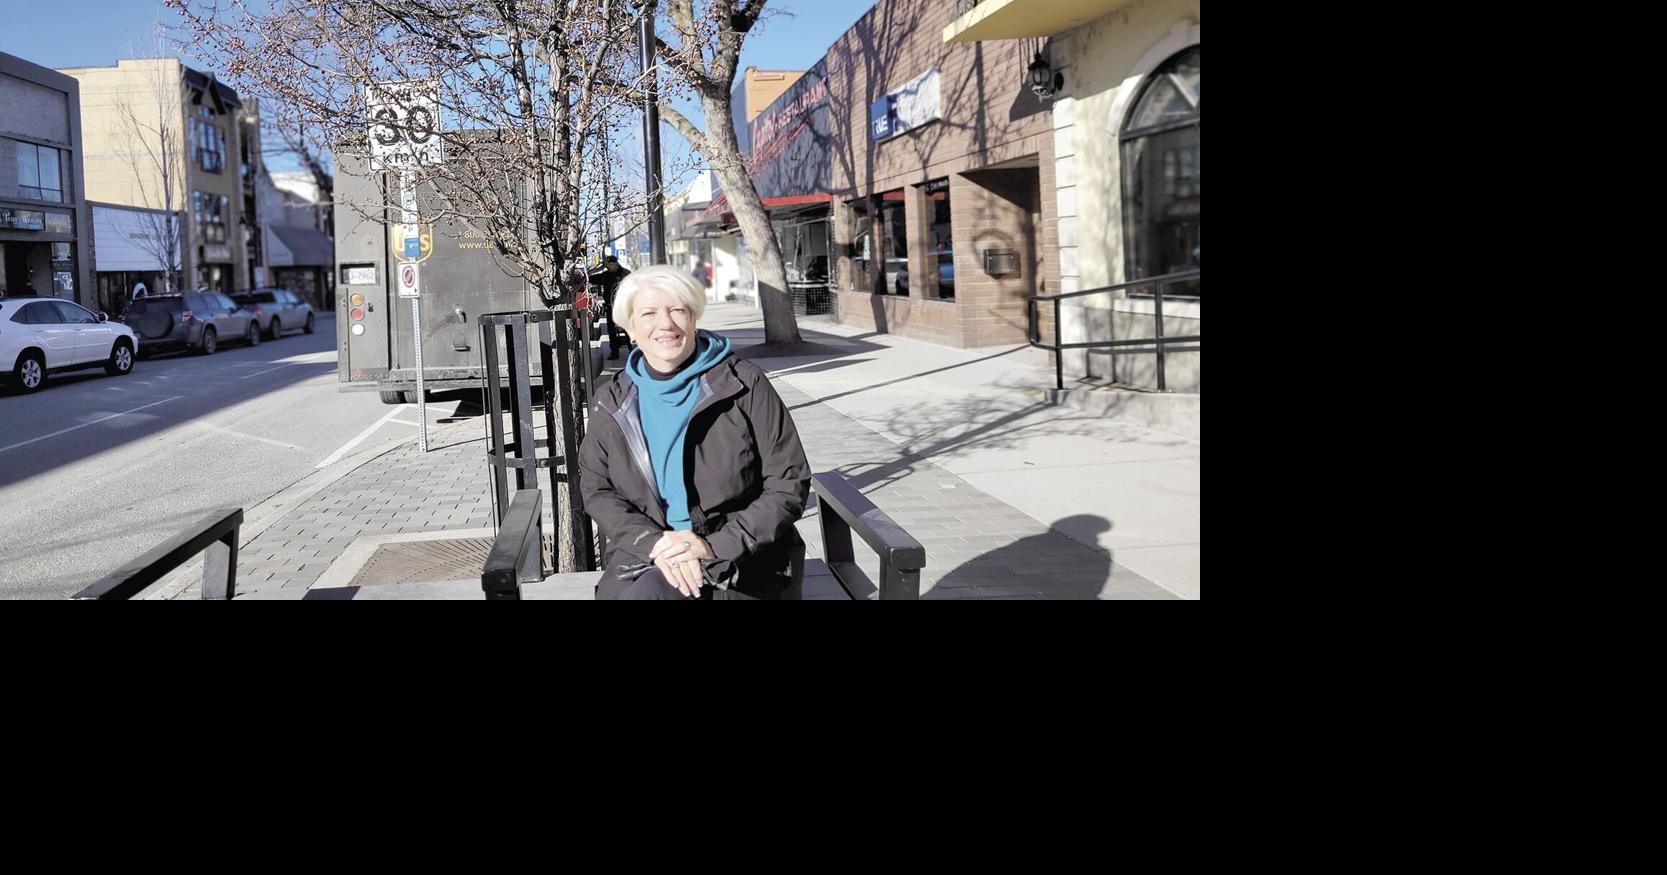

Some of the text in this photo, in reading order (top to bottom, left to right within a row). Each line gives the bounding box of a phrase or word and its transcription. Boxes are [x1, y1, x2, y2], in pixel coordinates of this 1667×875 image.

[375, 105, 433, 146] 30
[382, 147, 429, 163] kmh
[393, 223, 430, 251] US
